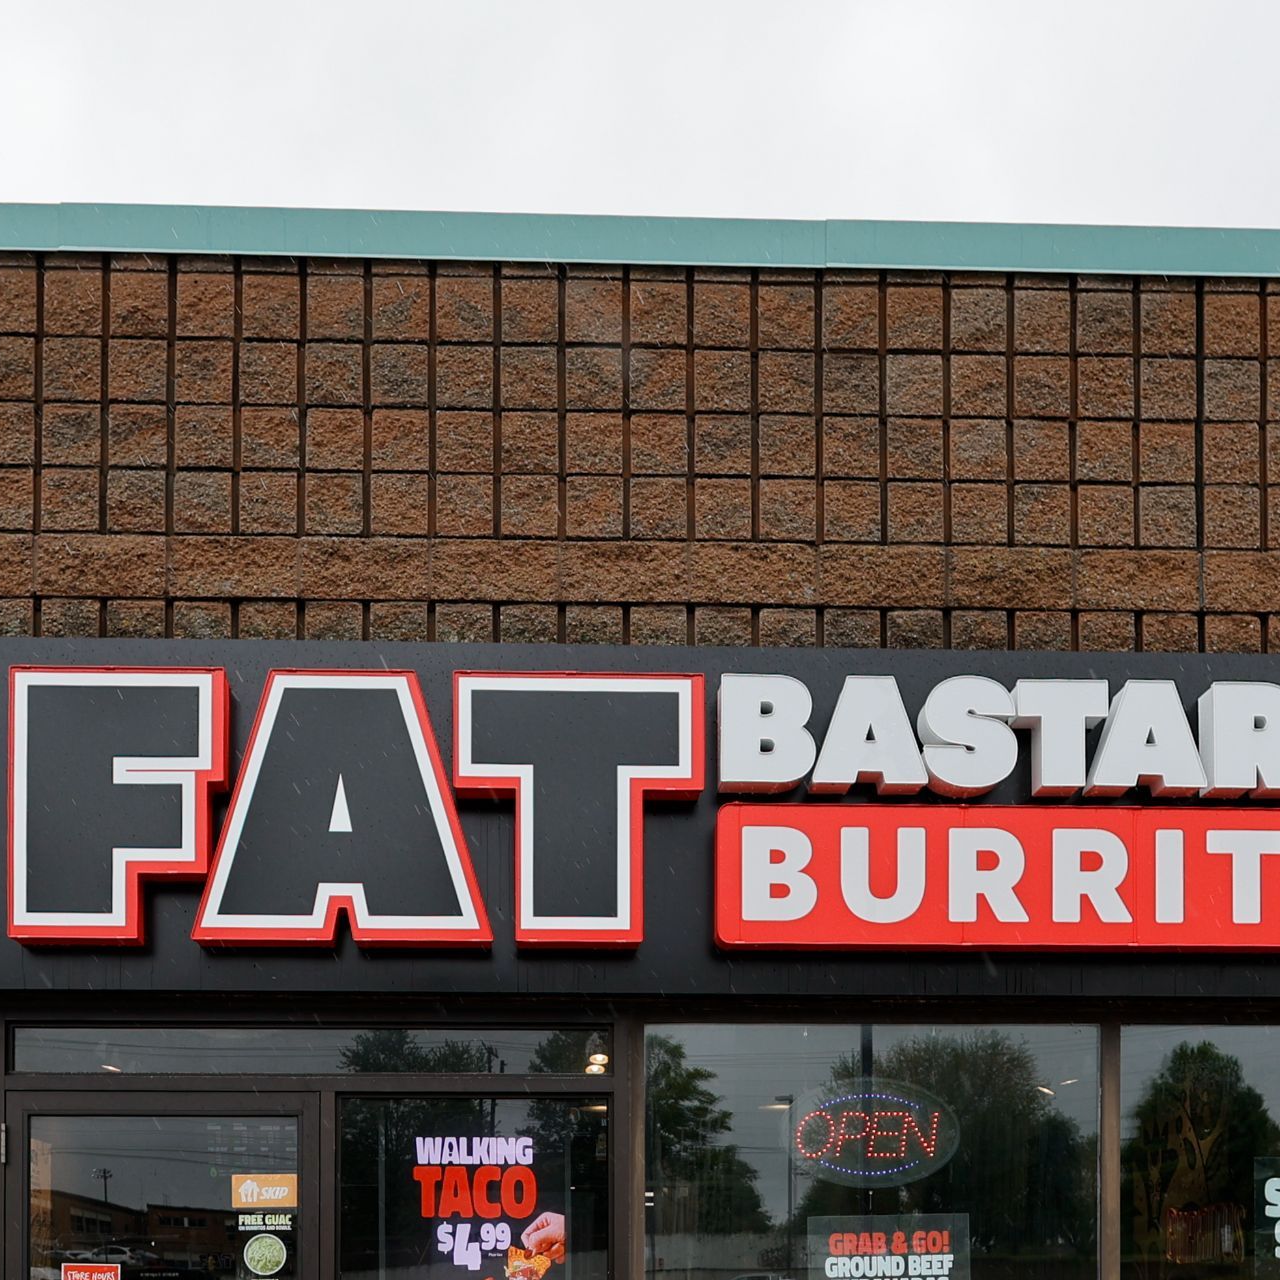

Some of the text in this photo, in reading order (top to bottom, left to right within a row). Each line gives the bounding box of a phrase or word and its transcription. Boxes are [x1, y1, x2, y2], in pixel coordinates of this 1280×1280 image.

[7, 665, 706, 946] FAT
[796, 1111, 940, 1158] OPEN
[416, 1136, 534, 1165] WALKING
[260, 1186, 289, 1200] SKIP
[413, 1165, 537, 1219] TACO
[238, 1214, 292, 1225] FREE GUAC
[828, 1230, 951, 1255] GRAB & GO!
[67, 1271, 115, 1280] STORE HOURS
[824, 1254, 954, 1278] GROUND BEEF
